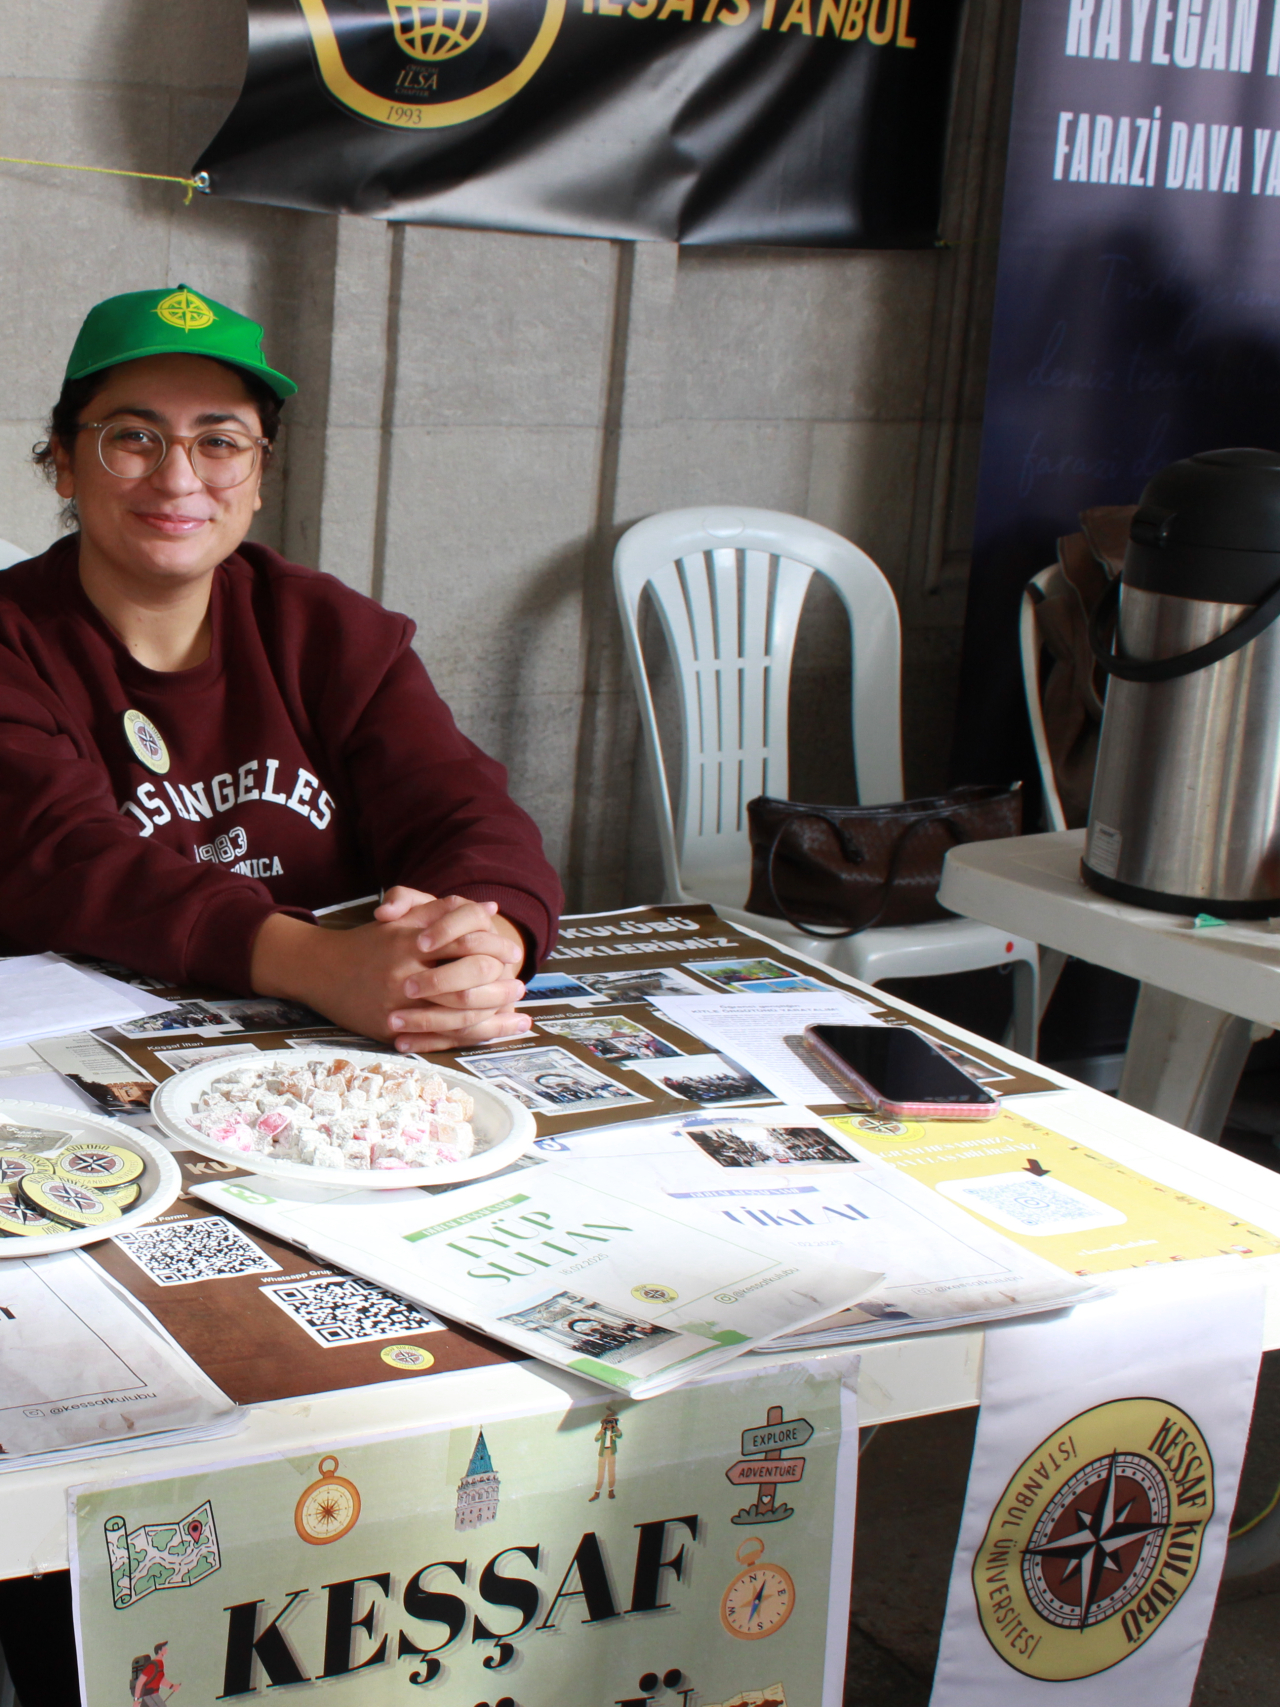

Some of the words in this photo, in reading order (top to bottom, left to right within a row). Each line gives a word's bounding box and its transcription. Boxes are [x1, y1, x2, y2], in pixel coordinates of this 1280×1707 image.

[395, 69, 438, 90] ILSA
[386, 106, 422, 125] 1993
[1053, 105, 1162, 187] FARAZİ
[1165, 121, 1243, 193] DAVA
[120, 782, 171, 837] OS
[163, 759, 336, 830] ANGELES
[230, 855, 284, 878] NICA
[558, 917, 701, 939] KULÜBÜ
[531, 1011, 566, 1021] ırklareli
[446, 1211, 555, 1259] EYÜP
[467, 1217, 634, 1287] SULTAN
[260, 1270, 309, 1284] Whatsapp
[309, 1269, 333, 1277] Grup
[48, 1391, 158, 1416] @kessafkulubu
[752, 1427, 798, 1448] EXPLORE
[737, 1464, 798, 1479] ADVENTURE
[1147, 1416, 1208, 1510] KEŞŞAF
[1000, 1435, 1078, 1529] İSTANBUL
[1120, 1519, 1203, 1644] KULÜBÜ
[216, 1513, 699, 1699] KEŞŞAF
[984, 1538, 1043, 1660] ÜNİVERSİTESİ
[756, 1621, 764, 1631] S
